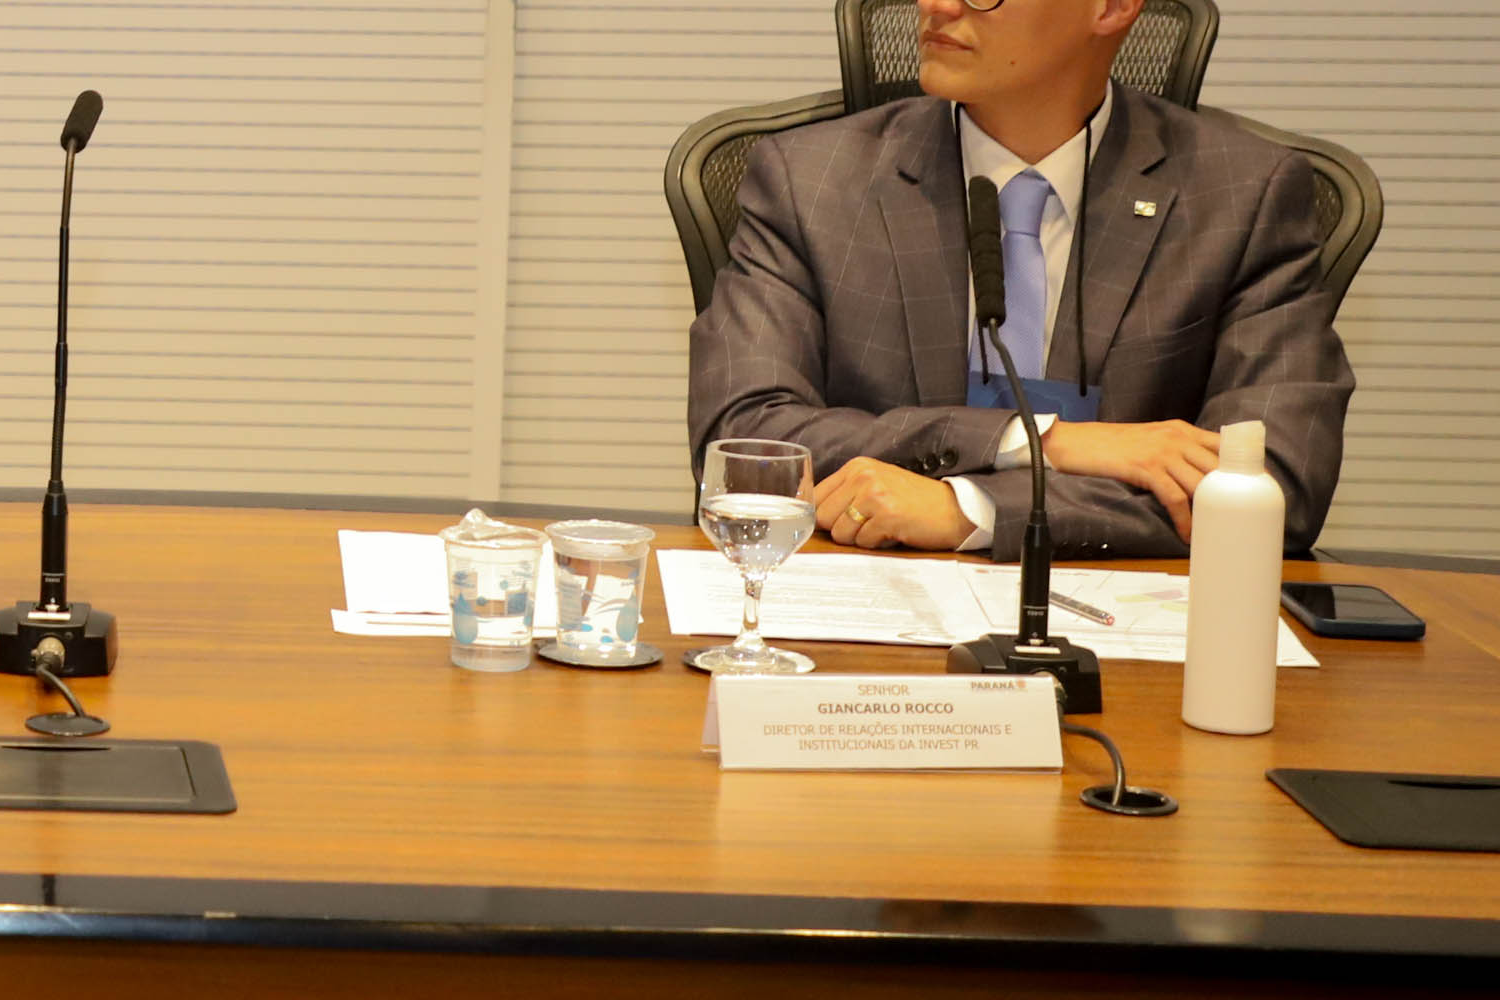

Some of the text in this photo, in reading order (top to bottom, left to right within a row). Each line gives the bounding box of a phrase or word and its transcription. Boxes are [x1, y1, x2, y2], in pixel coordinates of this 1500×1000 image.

[857, 684, 910, 696] SENHOR
[971, 680, 1015, 691] PARANÁ
[817, 702, 954, 715] GIANCARLO ROCCO
[763, 721, 1012, 737] DIRETOR DE RELAÇÕES INTERNACIONAIS E
[799, 738, 978, 751] INSTITUCIONAIS DA INVEST PR
